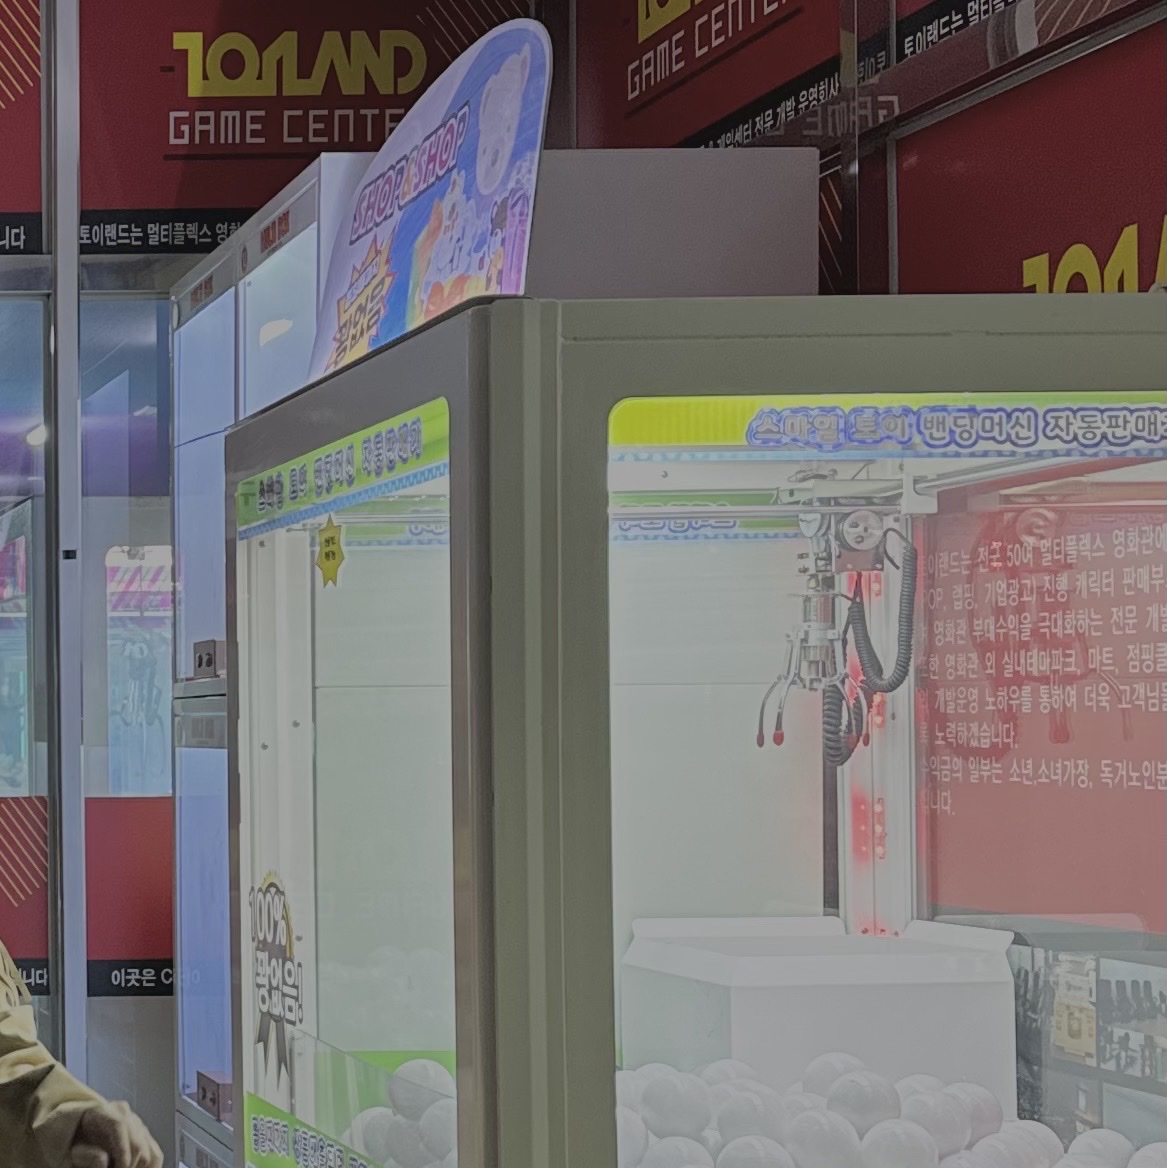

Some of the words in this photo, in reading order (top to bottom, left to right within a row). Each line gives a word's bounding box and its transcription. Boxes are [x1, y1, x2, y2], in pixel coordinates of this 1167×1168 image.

[627, 29, 686, 101] GAME
[694, 0, 788, 59] CENT
[169, 110, 266, 145] GAME
[282, 108, 406, 144] CENTE
[79, 222, 143, 247] 토이랜드는
[147, 222, 213, 247] 멀티플렉스
[752, 414, 842, 443] 스마일
[853, 412, 910, 442] 토이
[922, 412, 1034, 443] 밴딩머신
[1046, 412, 1167, 443] 자동판매
[928, 549, 972, 578] 이랜드는
[1006, 542, 1033, 568] 50여
[1040, 532, 1106, 567] 멀티플렉스
[1043, 573, 1068, 603] 진행
[1075, 567, 1115, 600] 캐릭터
[1122, 563, 1167, 596] 판매부
[933, 618, 967, 647] 영화관
[972, 612, 1032, 644] 부대수익을
[1038, 607, 1104, 641] 극대화하는
[1110, 604, 1138, 636] 전문
[944, 651, 979, 681] 영화관
[984, 651, 996, 677] 외
[1002, 647, 1081, 678] 실내테마파크,
[1088, 645, 1119, 675] 마트,
[934, 686, 979, 714] 개발운영
[984, 684, 1032, 714] 노하우를
[1038, 682, 1078, 714] 통하여
[1084, 682, 1111, 713] 더욱
[934, 720, 1019, 749] 노력하겠습니다.
[967, 756, 1003, 784] 일부는
[249, 882, 287, 947] 100%
[110, 967, 157, 988] 이곳은
[256, 949, 303, 1026] 꽝없음!
